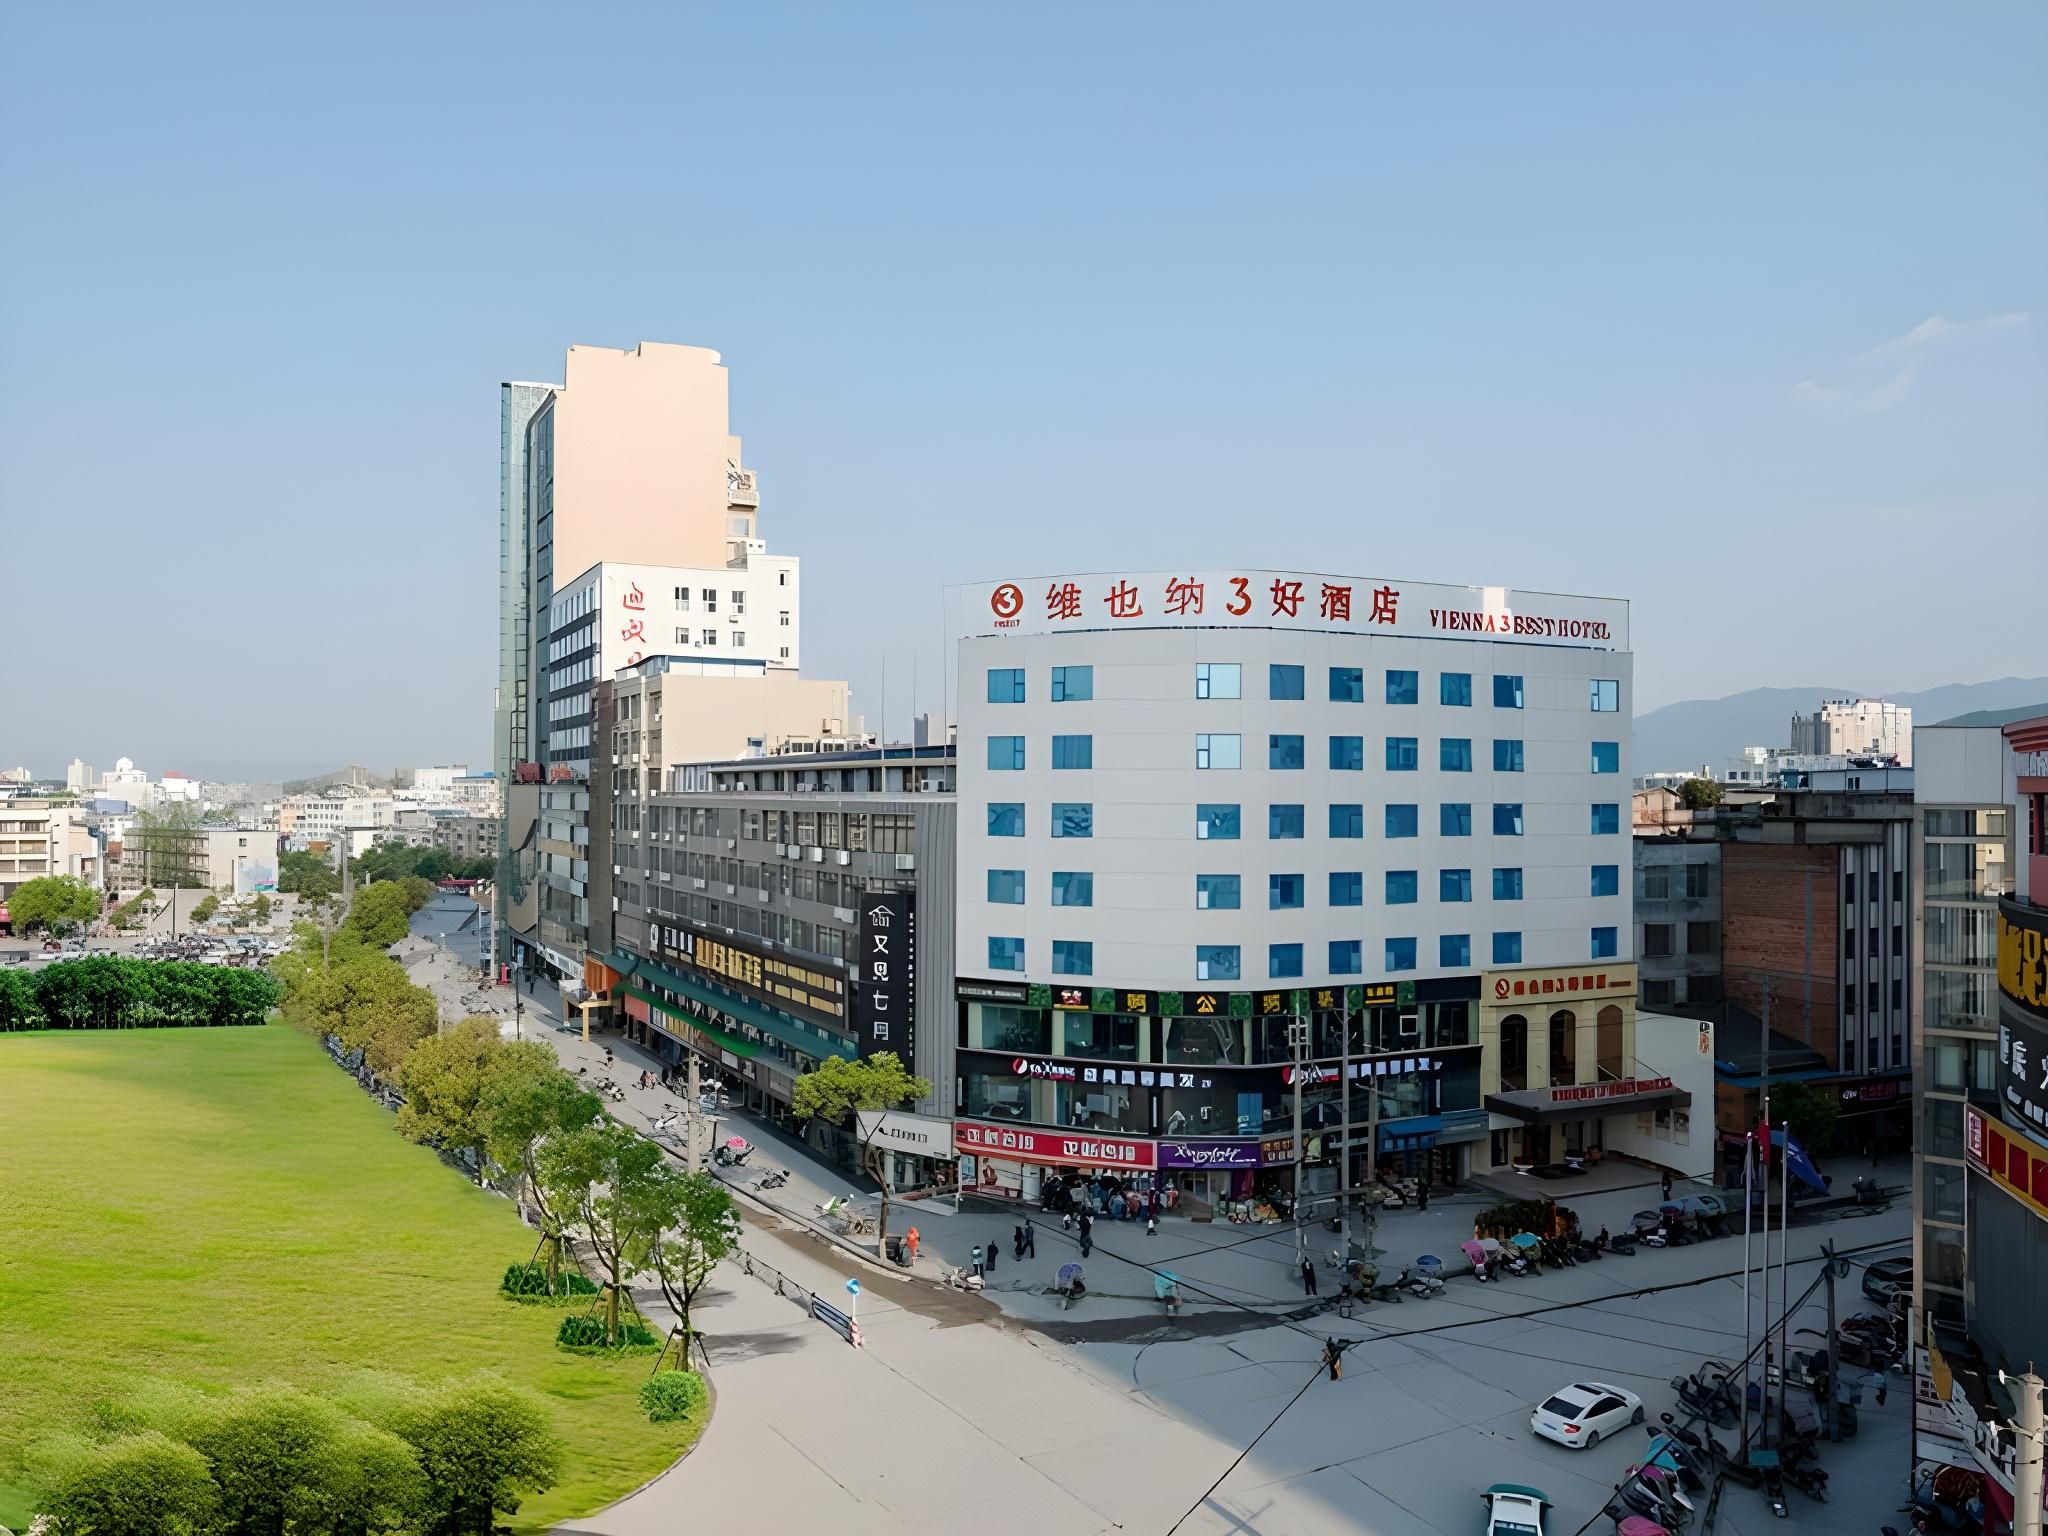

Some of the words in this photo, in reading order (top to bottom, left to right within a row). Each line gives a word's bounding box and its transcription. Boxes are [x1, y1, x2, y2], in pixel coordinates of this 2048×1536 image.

[1046, 576, 1401, 625] 维也纳3好酒店
[1430, 609, 1496, 633] VIENNA
